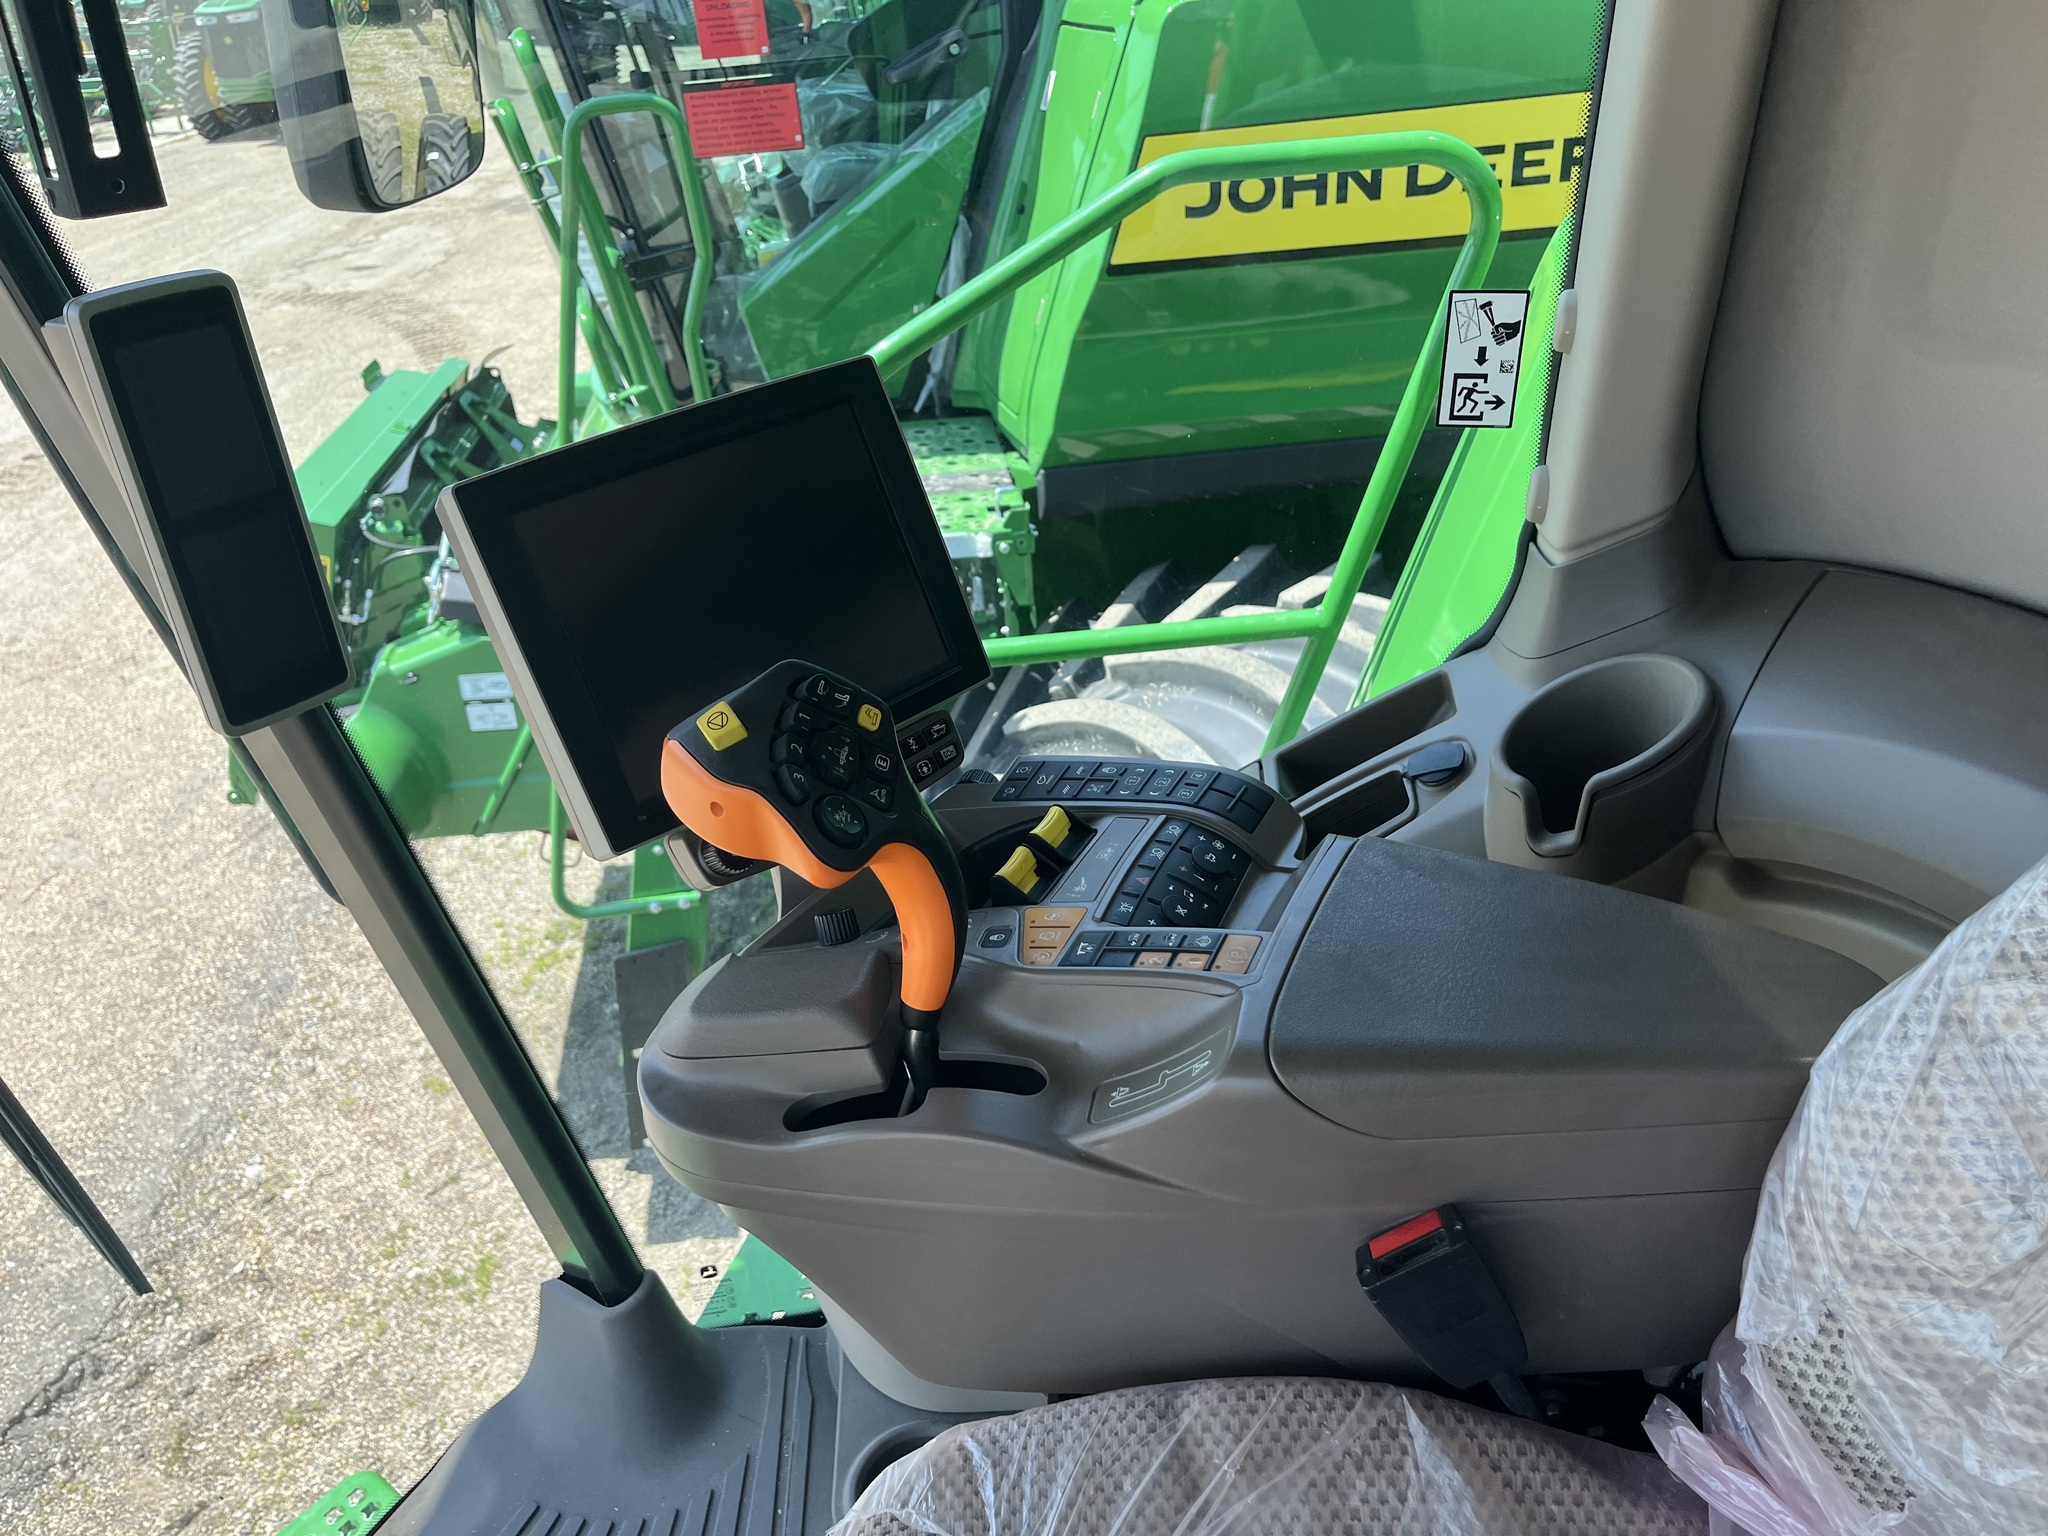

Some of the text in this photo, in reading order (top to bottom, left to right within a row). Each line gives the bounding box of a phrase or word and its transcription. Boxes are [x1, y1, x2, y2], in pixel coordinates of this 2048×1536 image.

[1185, 168, 1382, 219] JOHN
[790, 743, 803, 754] 2
[793, 772, 805, 782] 3
[1149, 957, 1164, 965] 2
